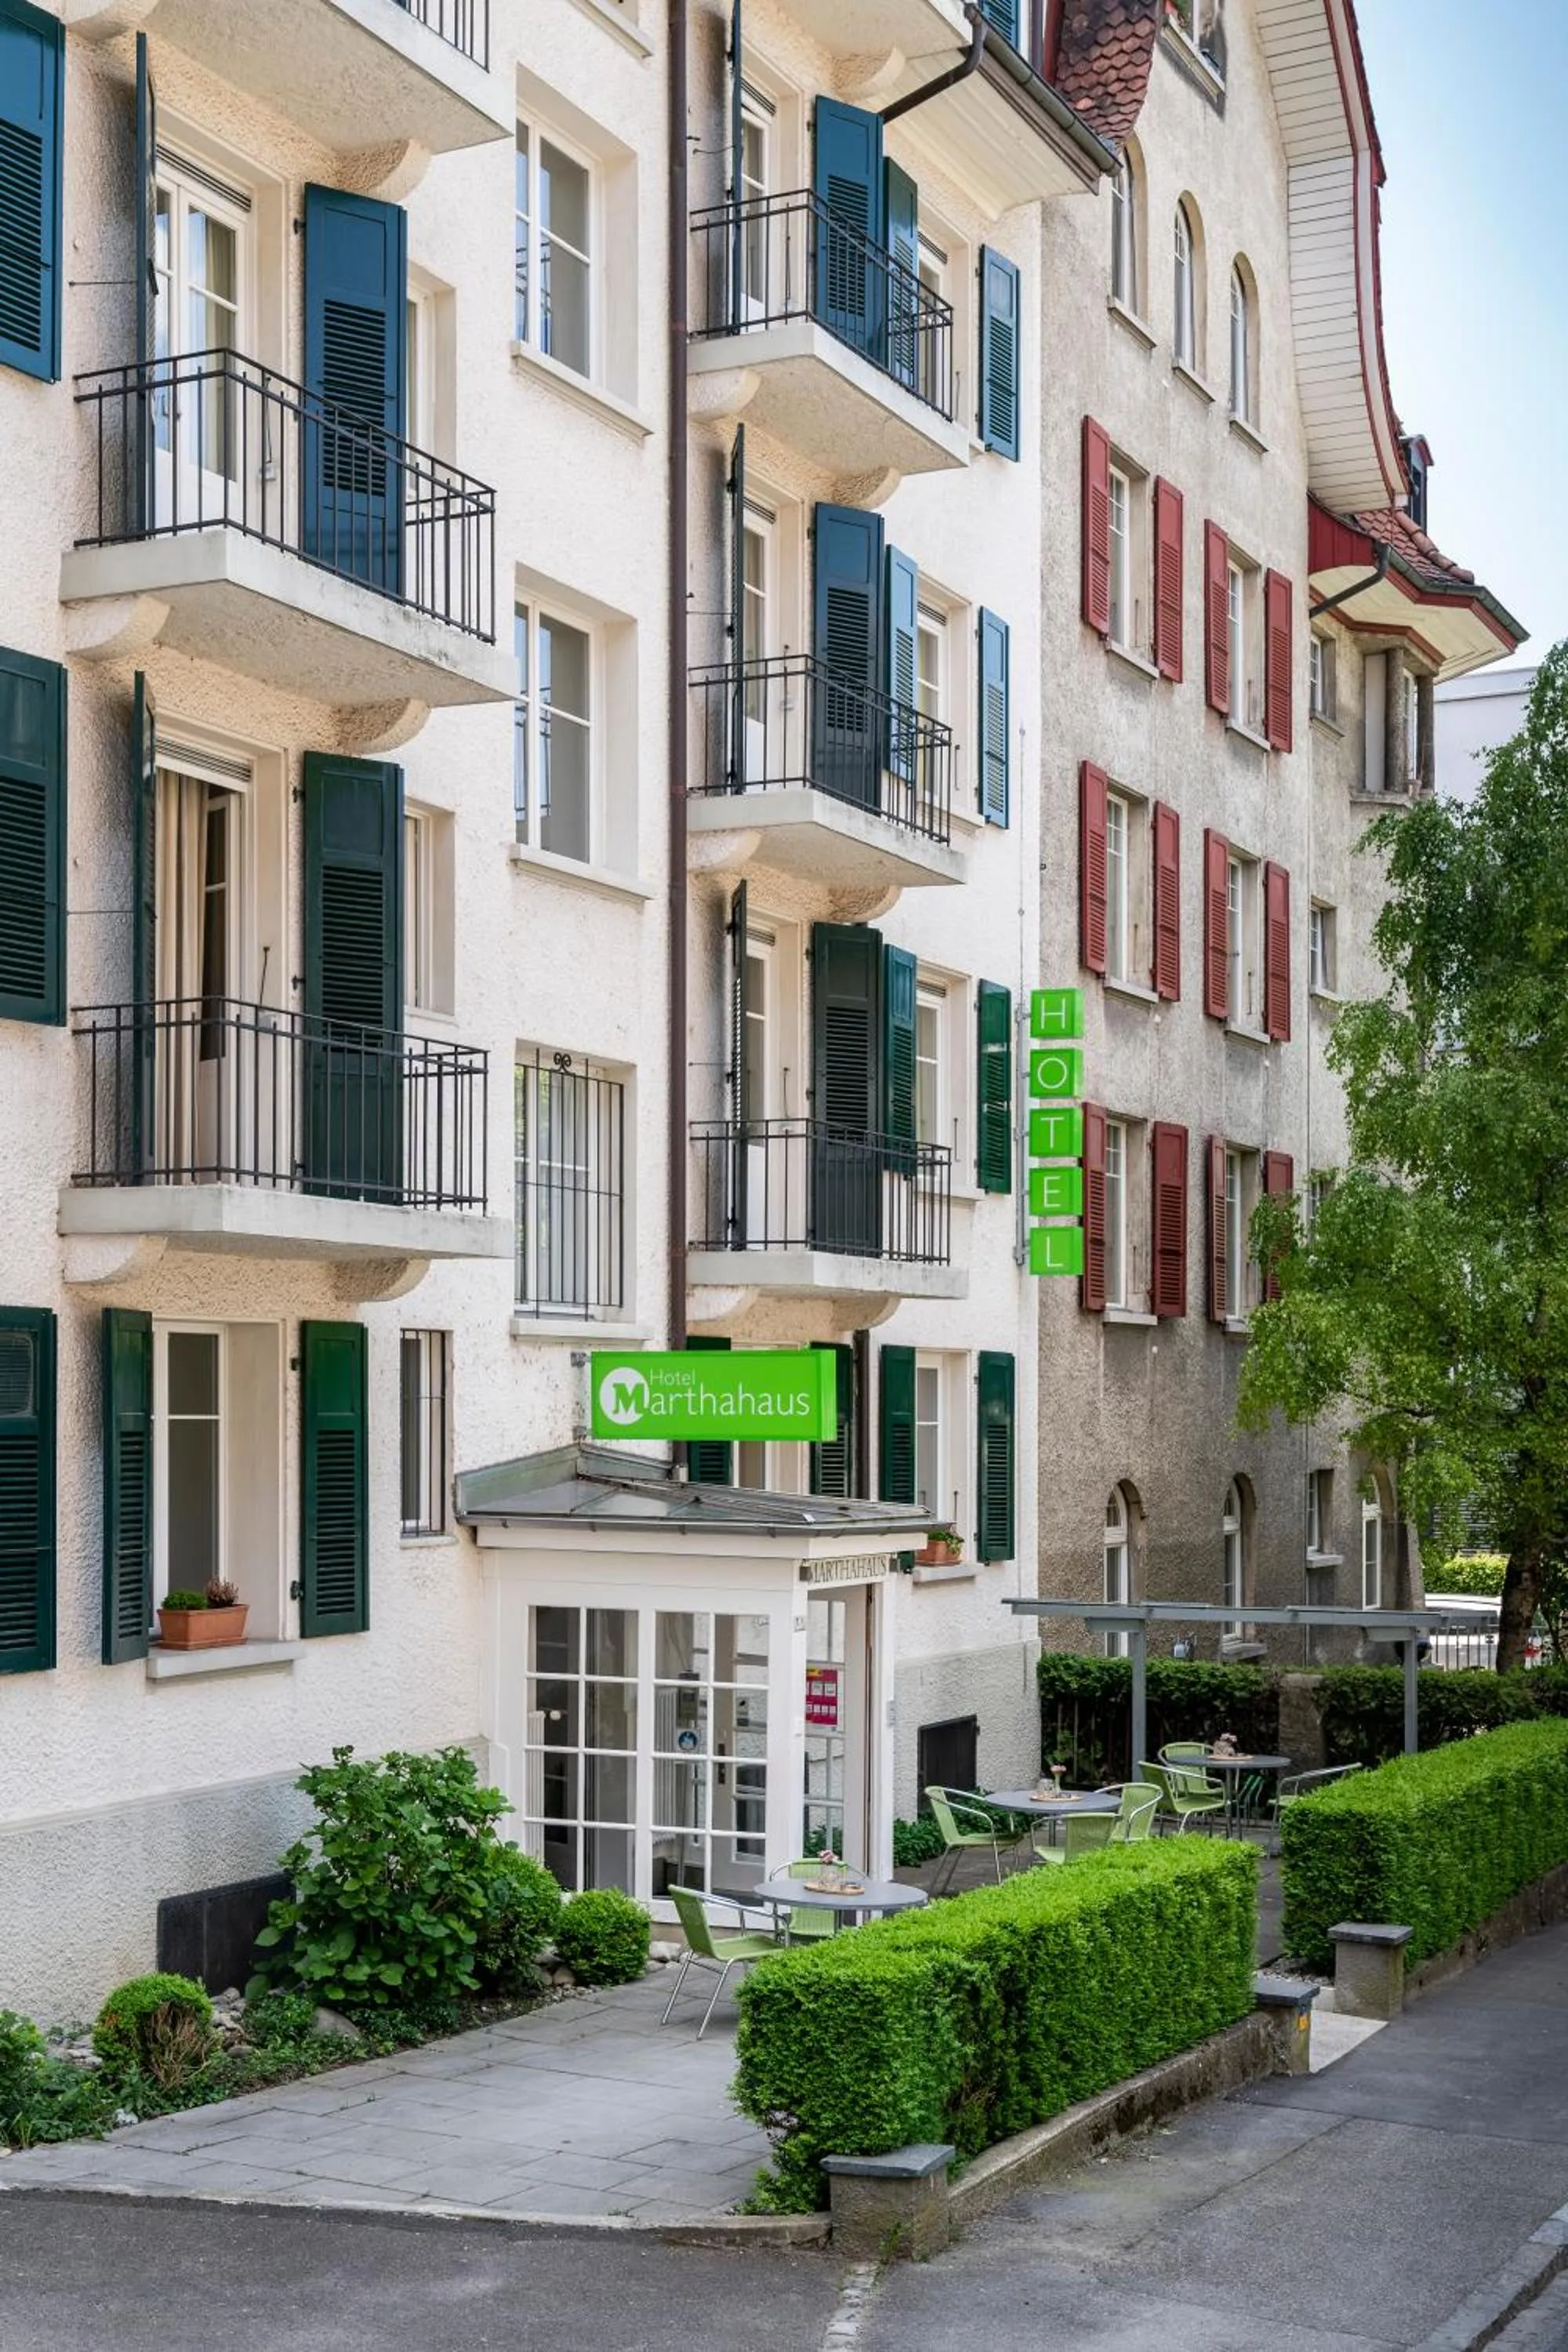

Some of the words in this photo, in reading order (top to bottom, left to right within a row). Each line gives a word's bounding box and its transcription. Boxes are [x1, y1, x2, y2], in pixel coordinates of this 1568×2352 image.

[1038, 997, 1068, 1267] HOTEL
[650, 1369, 695, 1386] Hotel
[612, 1381, 810, 1416] Marthahaus
